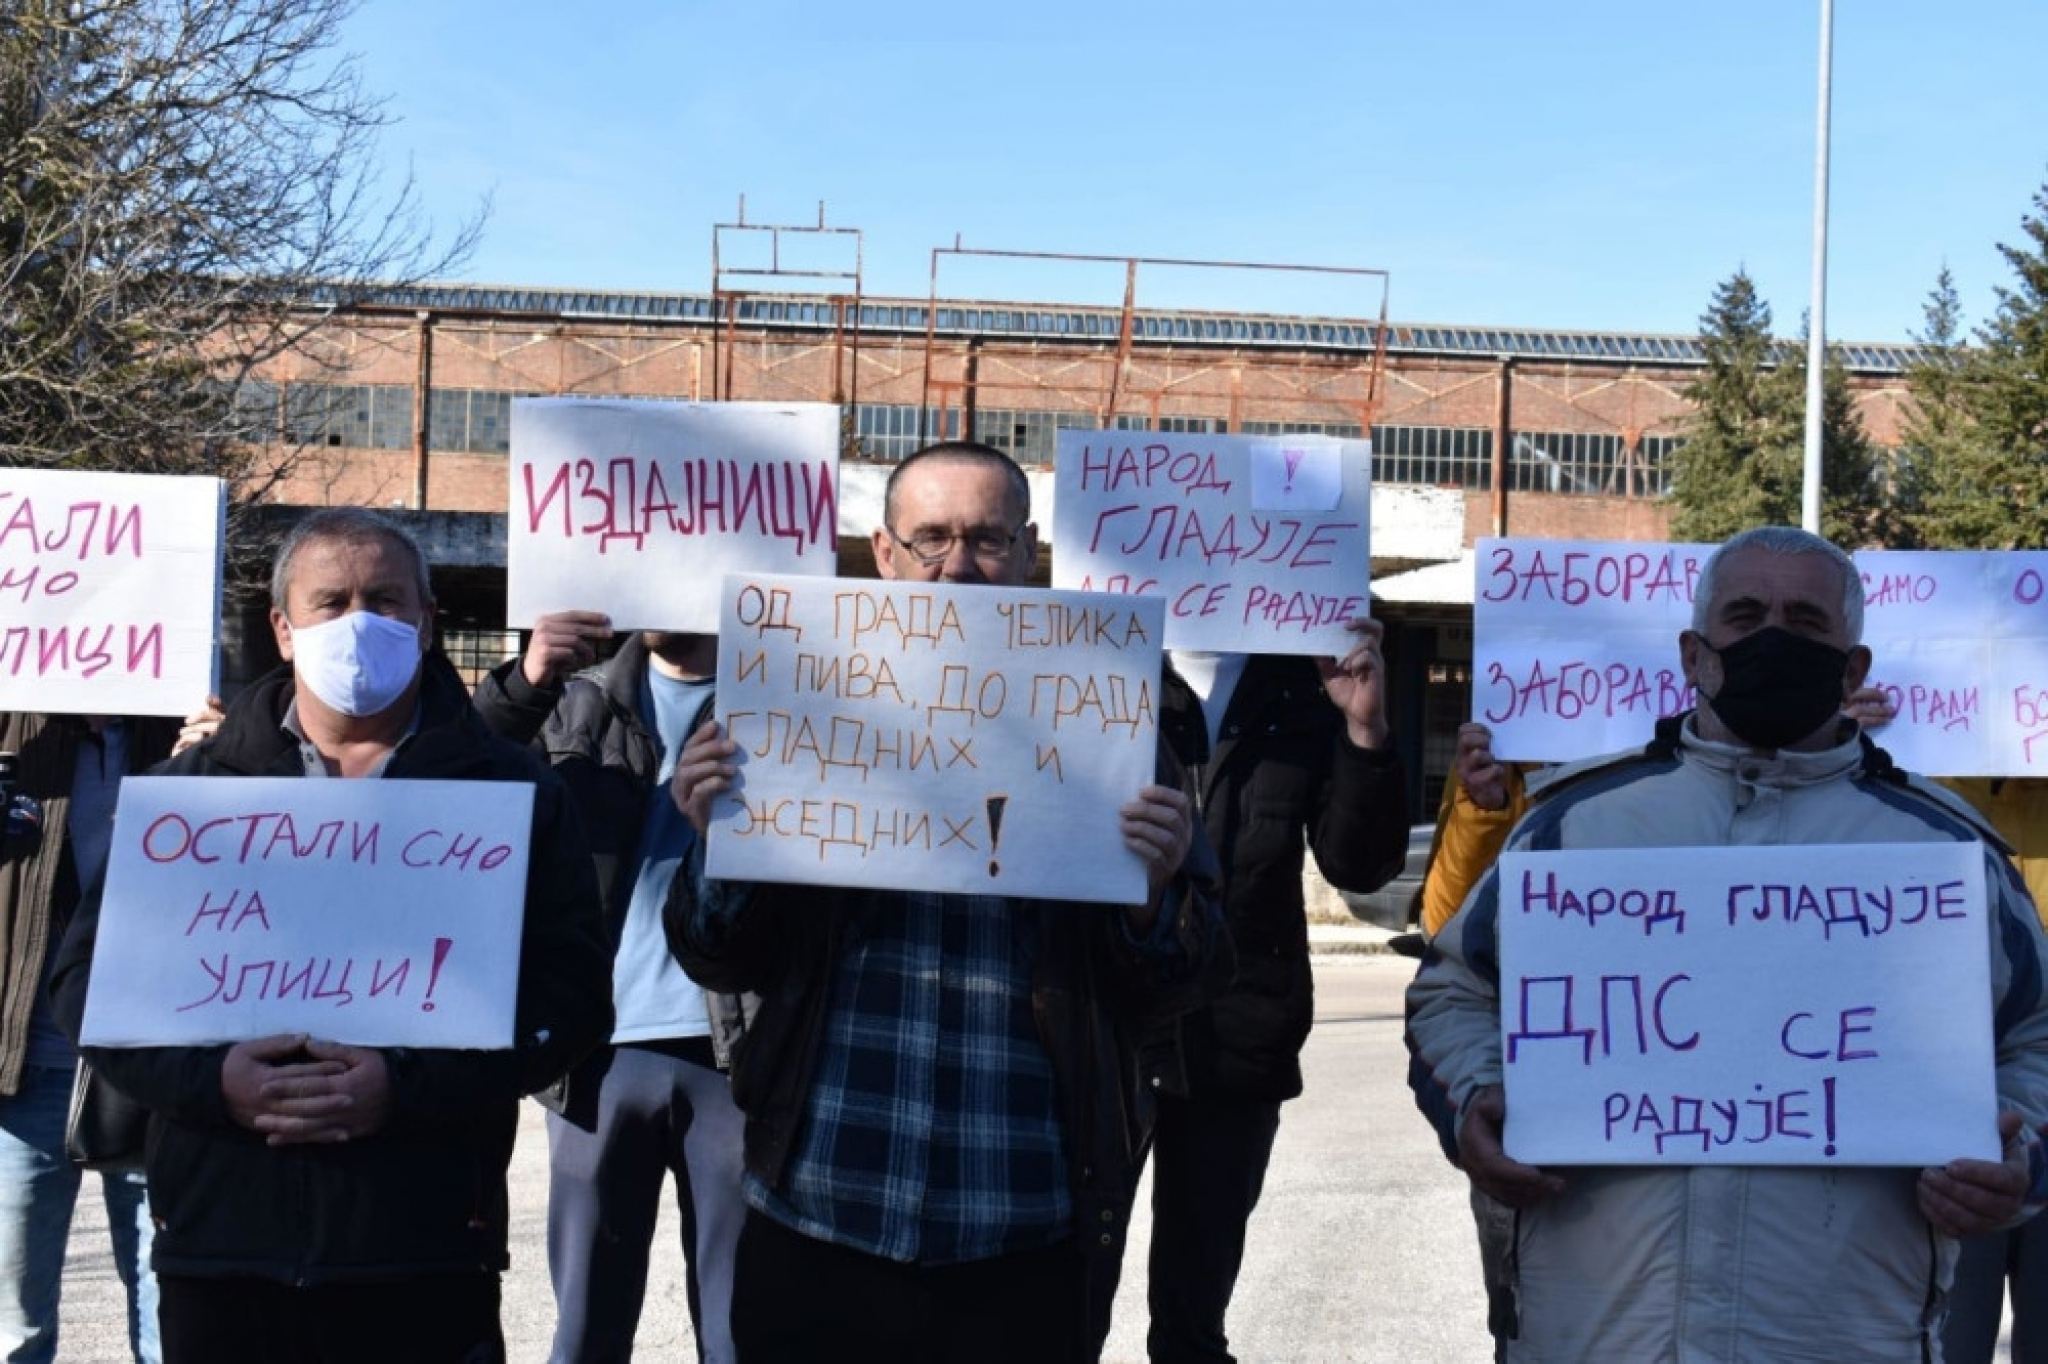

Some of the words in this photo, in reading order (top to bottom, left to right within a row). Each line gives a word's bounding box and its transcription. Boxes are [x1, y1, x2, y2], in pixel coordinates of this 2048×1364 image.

[1081, 444, 1231, 497] НАРОД
[0, 491, 142, 559] АЛИ
[523, 458, 838, 555] ИЗДАЈНИЦИ
[1089, 505, 1358, 567] ГЛАДУЈЕ
[737, 584, 802, 643] ОД
[834, 592, 965, 651] ГРАДА
[997, 601, 1148, 649] ЧЕЛИКА
[1172, 583, 1231, 617] СЕ
[1244, 585, 1365, 632] РАДУЈЕ
[738, 650, 765, 684] И
[927, 665, 1006, 727] ДО
[1030, 674, 1155, 740] ГРАДА
[727, 711, 978, 782] ГЛАДНИХ
[1036, 743, 1063, 784] И
[142, 812, 379, 864] ОСТАЛИ
[402, 829, 512, 871] СМО
[186, 889, 271, 935] НА
[1728, 878, 1967, 941] ГЛАДУЈЕ
[1507, 973, 1699, 1065] ДПС
[1781, 1006, 1879, 1061] СЕ
